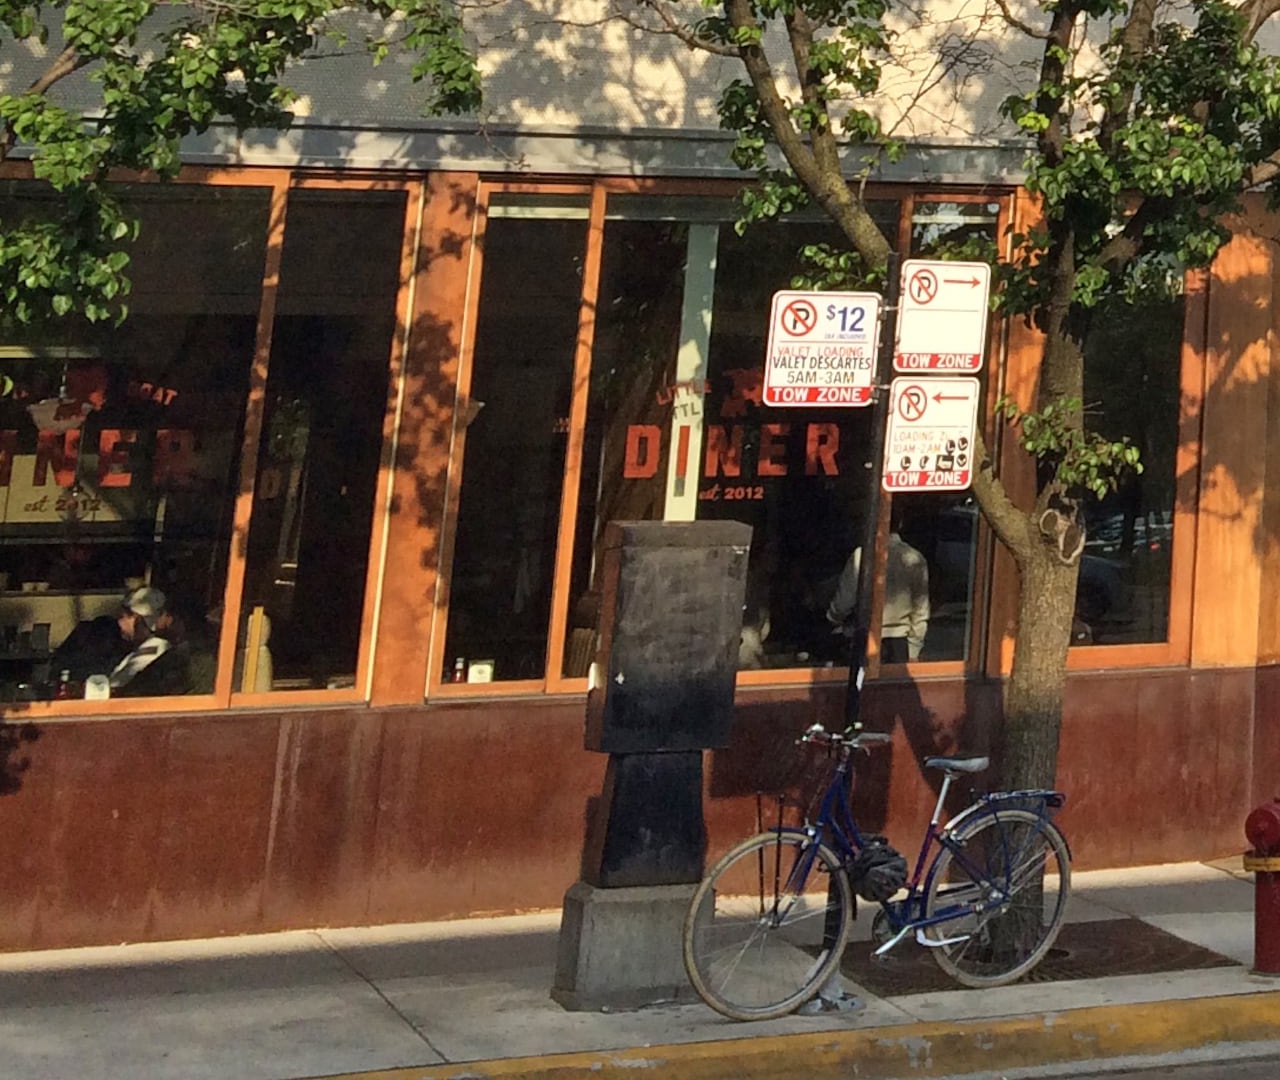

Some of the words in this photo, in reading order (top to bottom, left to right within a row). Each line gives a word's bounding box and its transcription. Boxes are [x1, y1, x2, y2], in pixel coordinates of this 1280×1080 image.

[778, 346, 810, 357] VALET
[818, 347, 864, 357] LOADING
[773, 356, 806, 369] VALET
[809, 356, 871, 370] DESCARTES
[902, 354, 931, 368] TOW
[936, 354, 974, 369] ZONE
[772, 388, 808, 402] TOW
[816, 388, 862, 402] ZONE
[622, 423, 841, 479] DINER
[891, 472, 919, 485] TOW
[926, 472, 962, 485] ZONE
[724, 486, 764, 500] 2012
[24, 495, 49, 513] est
